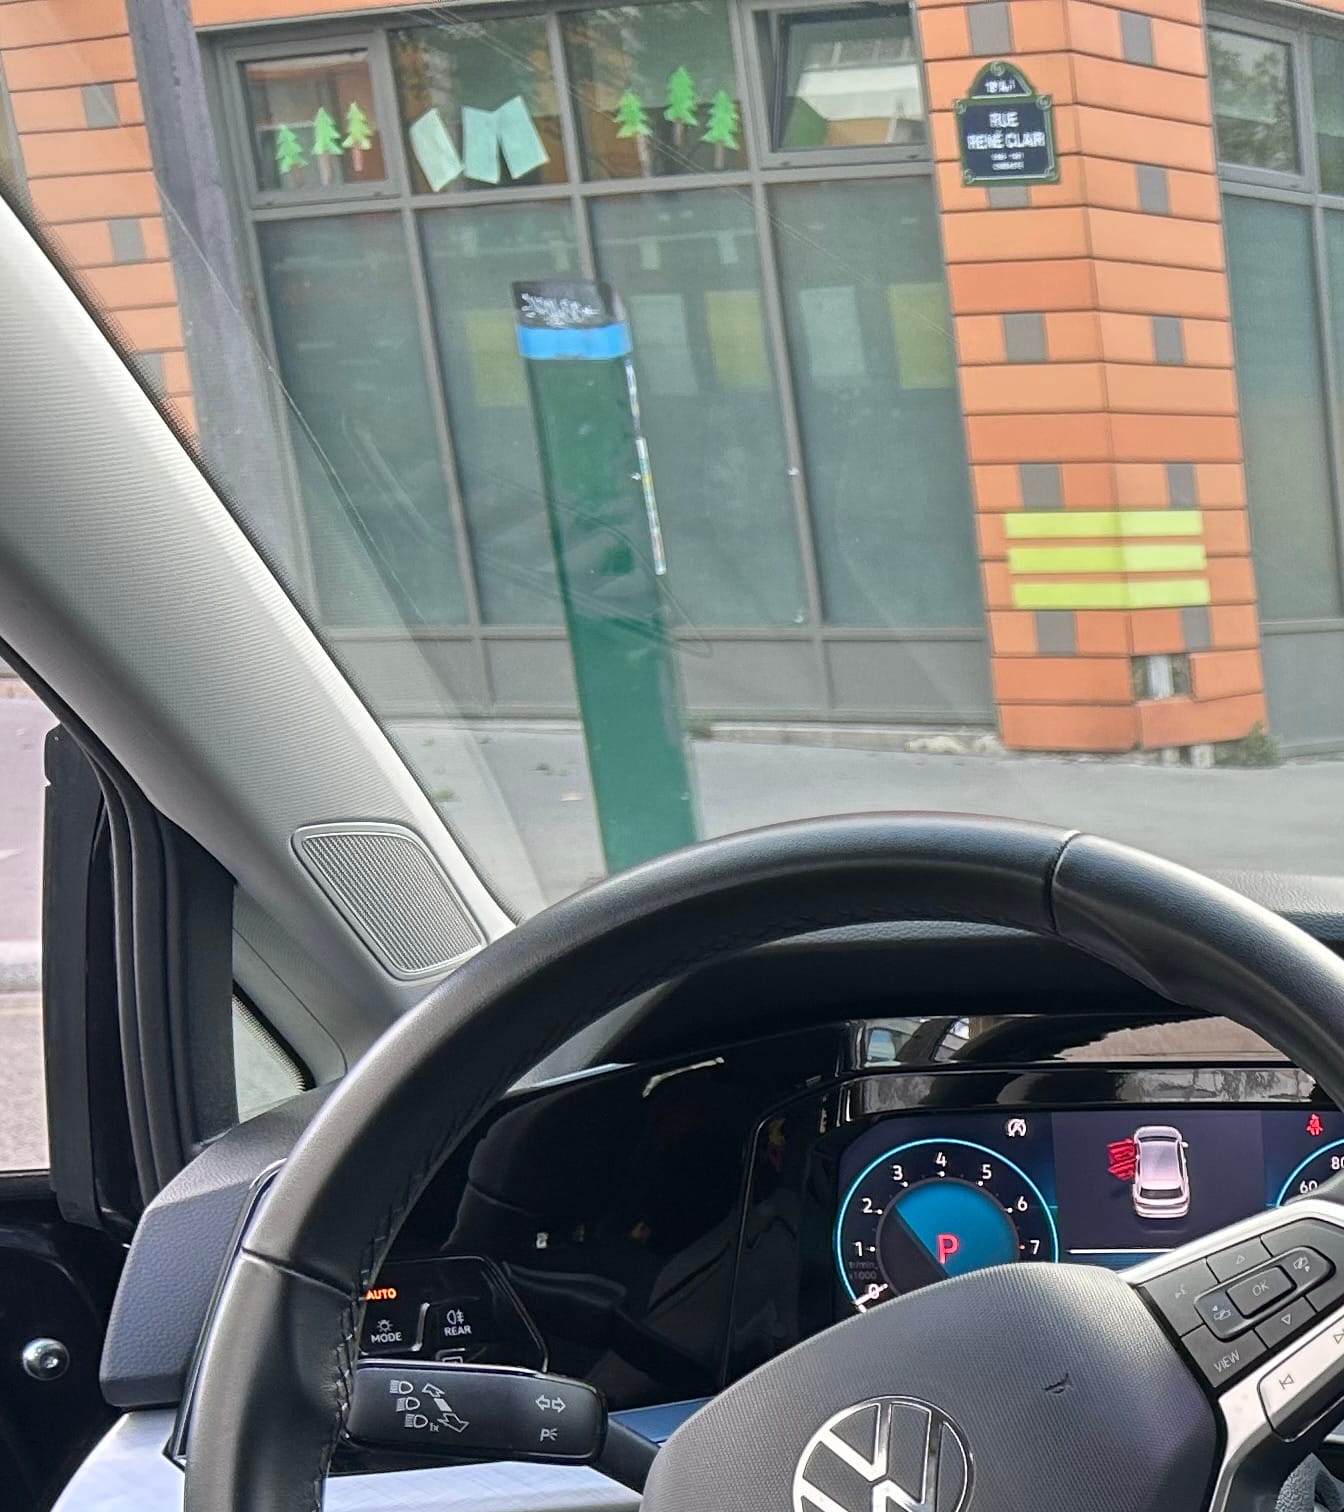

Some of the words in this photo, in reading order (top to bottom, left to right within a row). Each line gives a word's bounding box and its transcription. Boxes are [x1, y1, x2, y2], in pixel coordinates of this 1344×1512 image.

[989, 112, 1019, 128] RUE
[967, 129, 1004, 150] RENÉ
[1005, 131, 1046, 149] CLAIR
[935, 1152, 947, 1167] 4
[892, 1165, 903, 1181] 3
[982, 1164, 992, 1180] 5
[862, 1198, 873, 1214] 2
[1017, 1196, 1028, 1212] 6
[855, 1241, 864, 1257] 1
[937, 1234, 960, 1265] P
[1030, 1240, 1041, 1255] 7
[366, 1287, 397, 1301] AUTO
[1252, 1281, 1270, 1297] OK
[371, 1331, 402, 1344] MODE
[444, 1324, 472, 1336] REAR
[1214, 1349, 1240, 1373] VIEW
